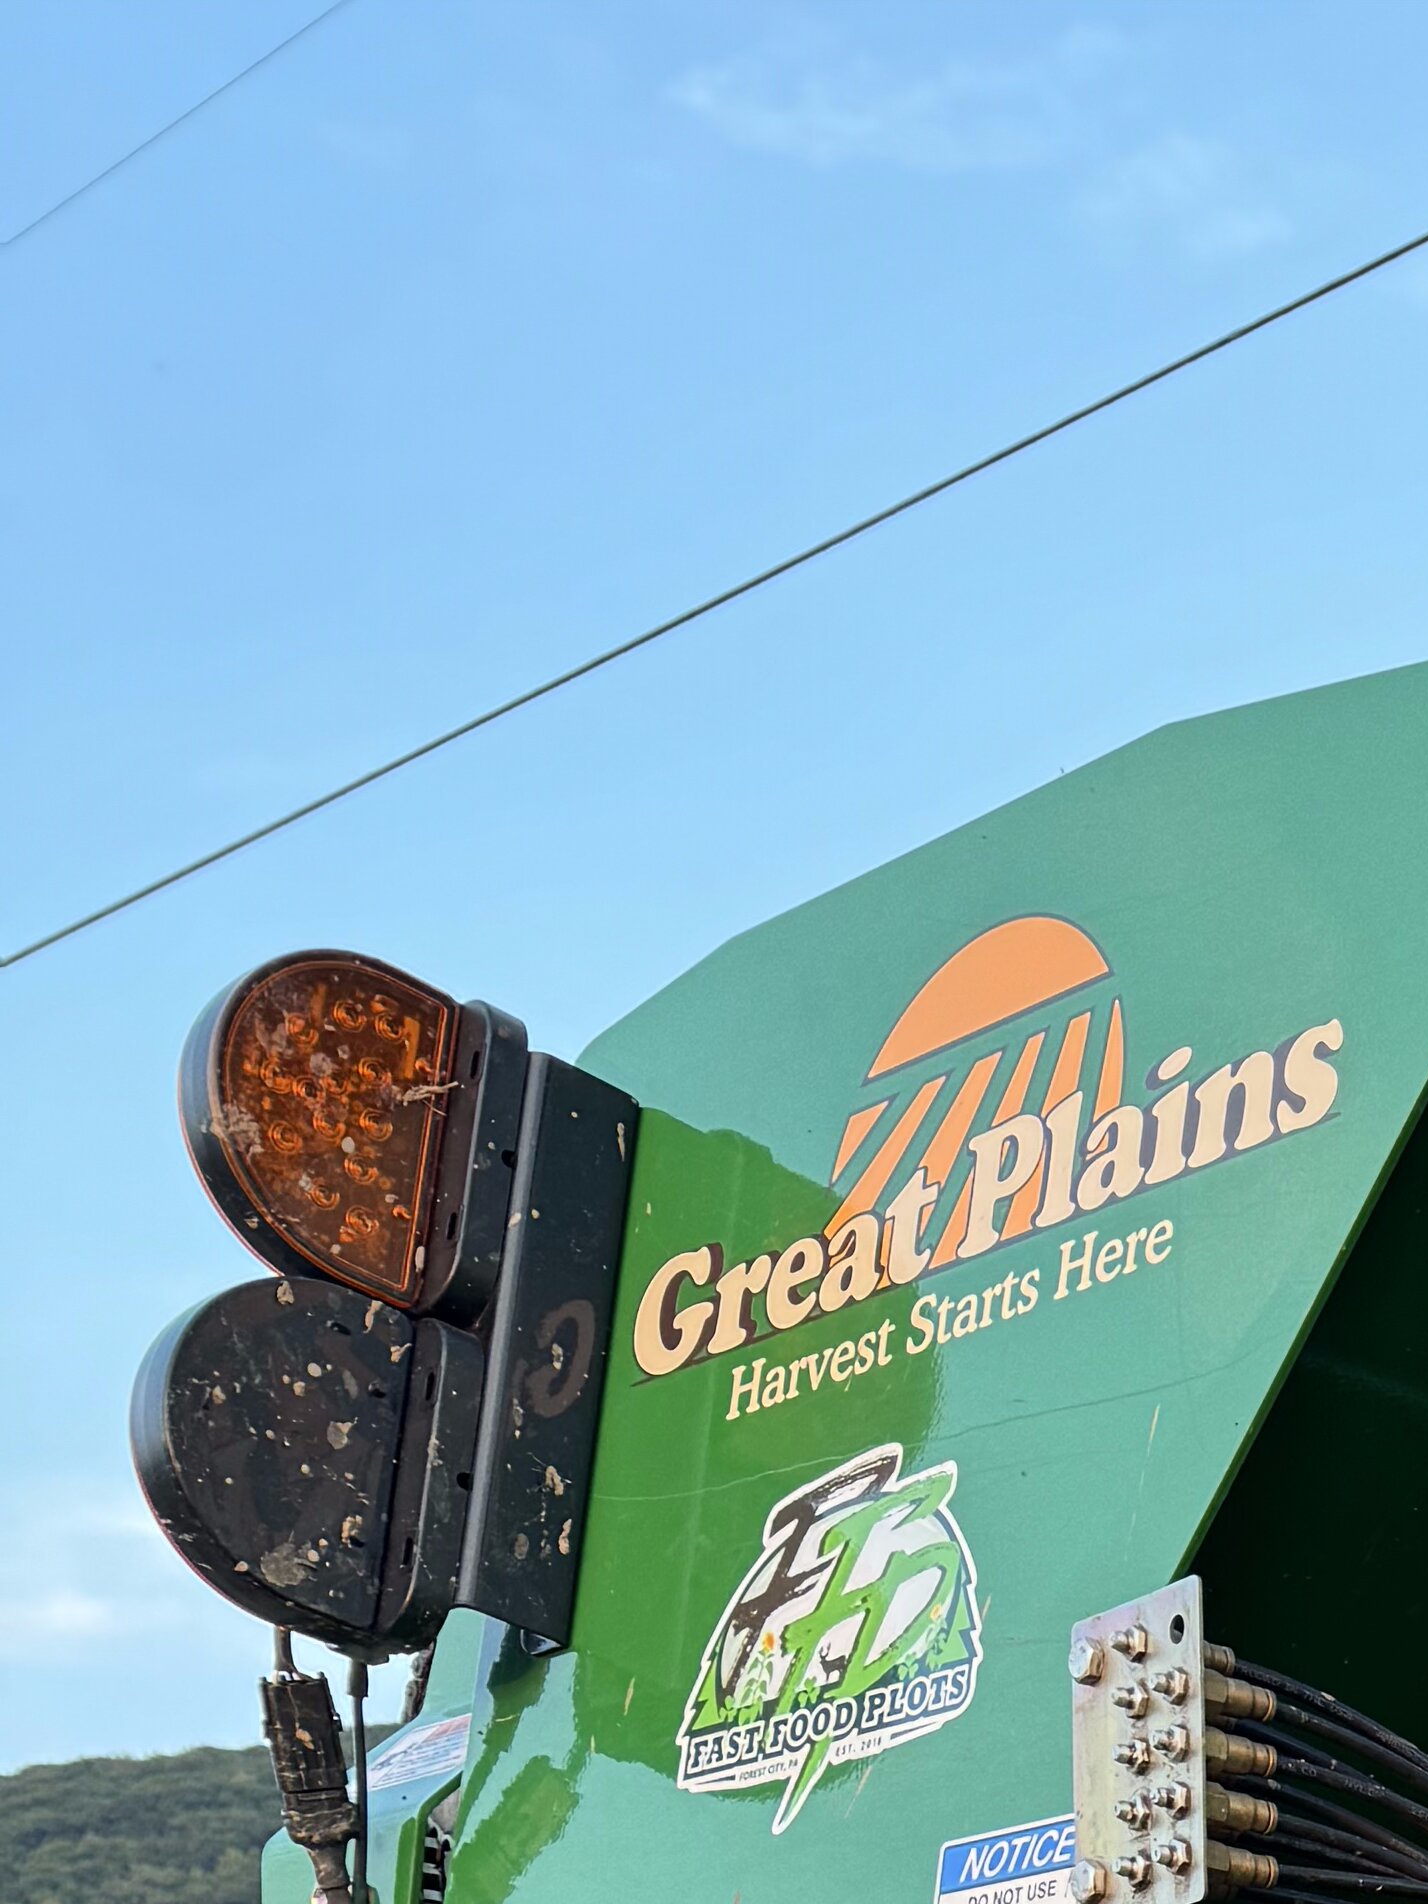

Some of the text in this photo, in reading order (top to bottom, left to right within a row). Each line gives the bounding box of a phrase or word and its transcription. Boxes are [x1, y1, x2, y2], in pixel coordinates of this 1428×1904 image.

[632, 1018, 1344, 1377] Great Plains
[725, 1218, 1174, 1421] Harvest Starts Here
[688, 1667, 967, 1771] FAST FOOD PLOTS
[738, 1766, 767, 1783] FOREST
[835, 1743, 857, 1758] EST.
[959, 1824, 1076, 1884] NOTICE
[1026, 1879, 1058, 1902] USE
